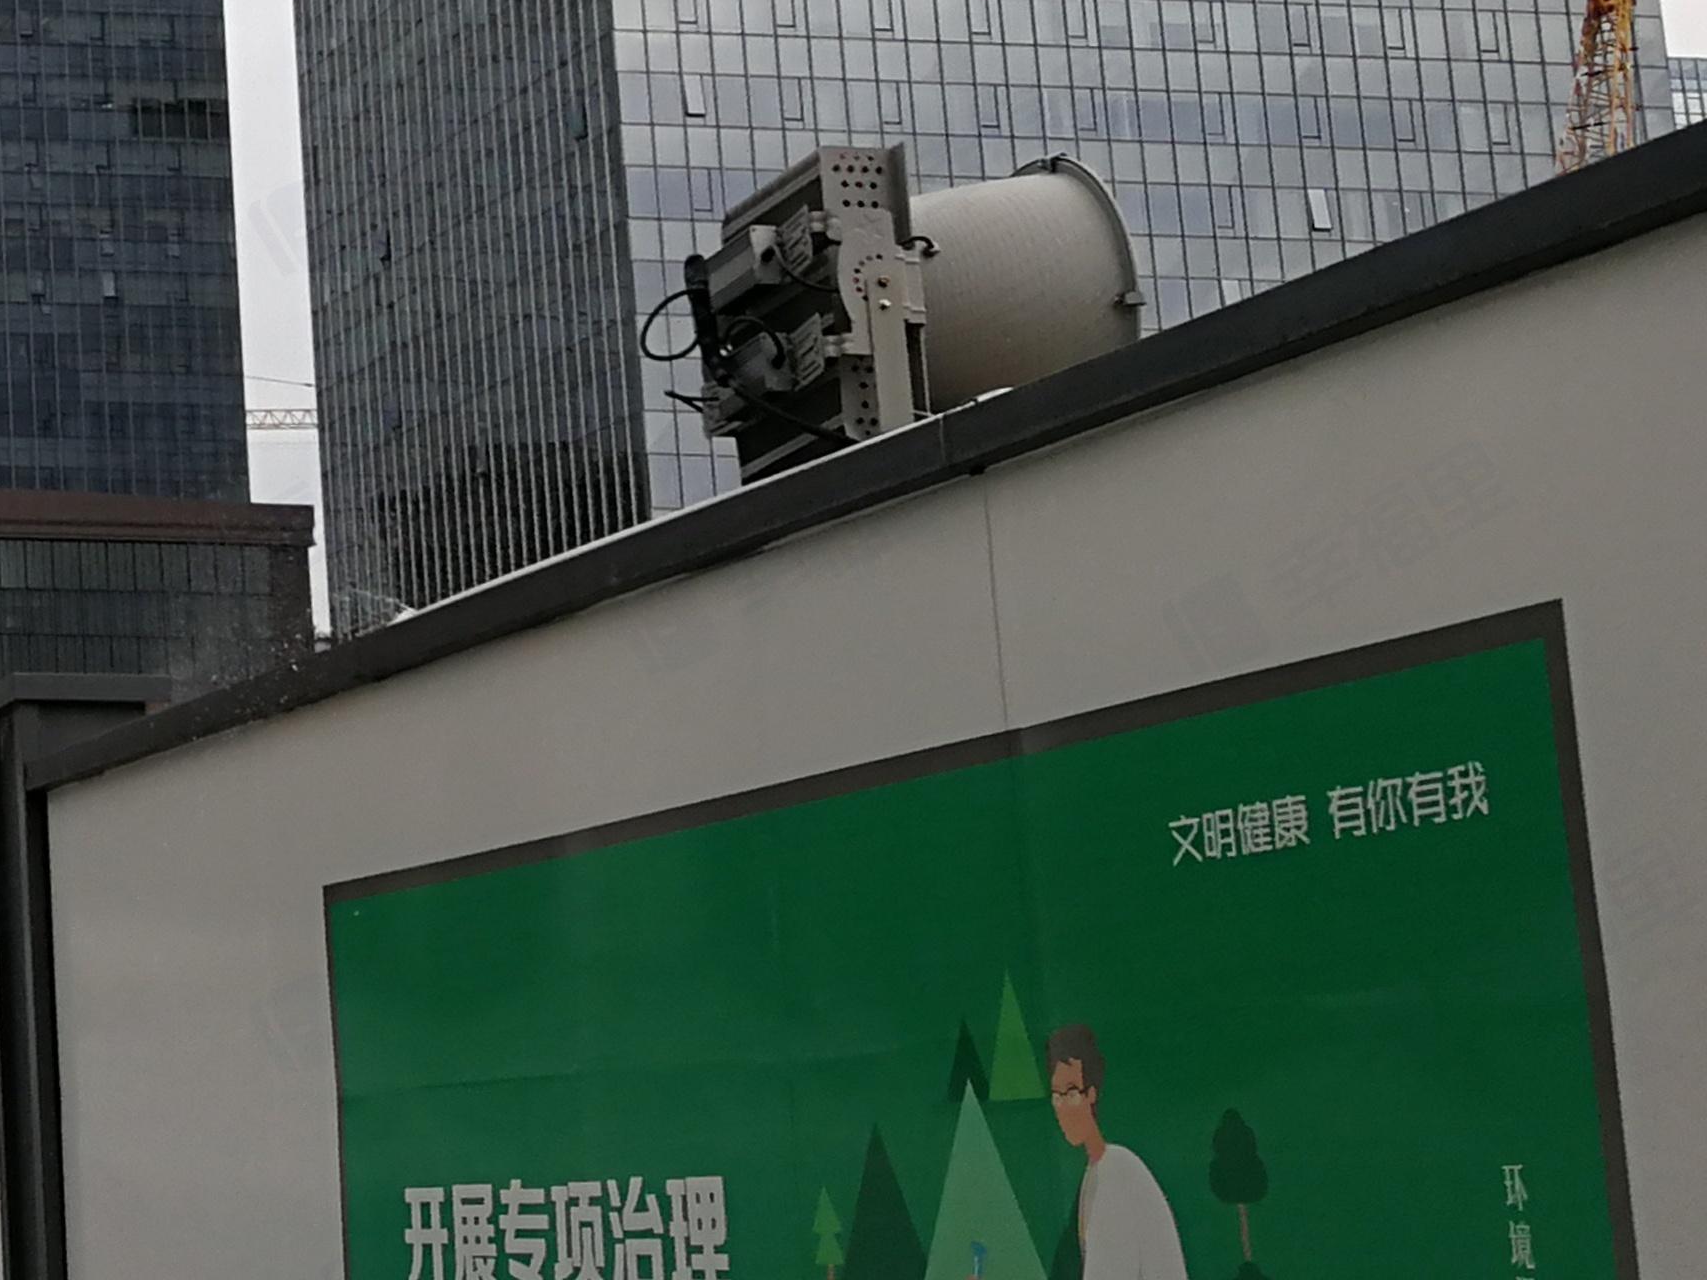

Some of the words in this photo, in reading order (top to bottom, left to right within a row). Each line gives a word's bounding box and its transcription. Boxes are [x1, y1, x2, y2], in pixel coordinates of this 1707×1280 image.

[1169, 793, 1310, 867] 文明健康
[1327, 761, 1489, 841] 有你有我
[404, 1176, 732, 1280] 开展专项治理
